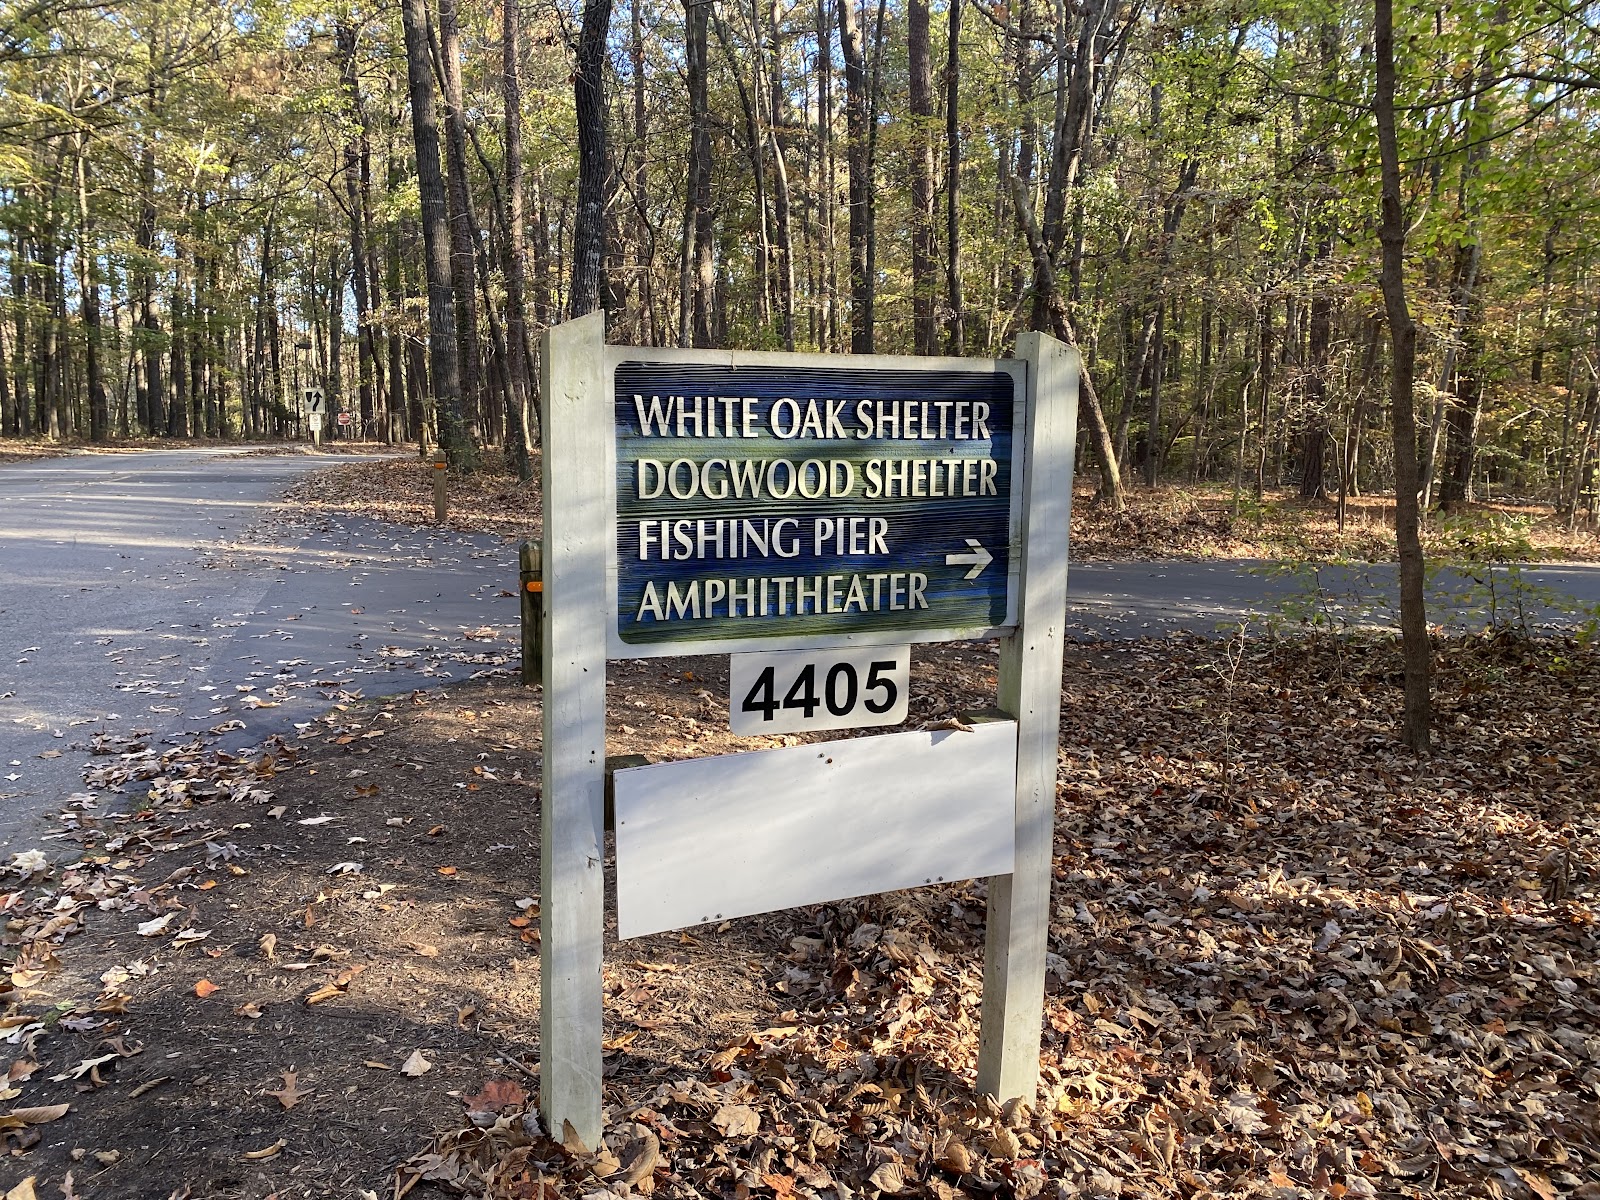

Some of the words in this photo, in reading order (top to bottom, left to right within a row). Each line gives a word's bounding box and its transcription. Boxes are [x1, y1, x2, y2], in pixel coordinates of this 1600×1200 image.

[634, 394, 759, 439] WHITE
[770, 398, 848, 439] OAK
[856, 400, 992, 440] SHELTER
[637, 458, 855, 500] DOGWOOD
[865, 458, 998, 498] SHELTER
[639, 518, 800, 561] FISHING
[814, 517, 890, 557] PIER
[635, 572, 930, 622] AMPHITHEATER
[741, 660, 898, 722] 4405
